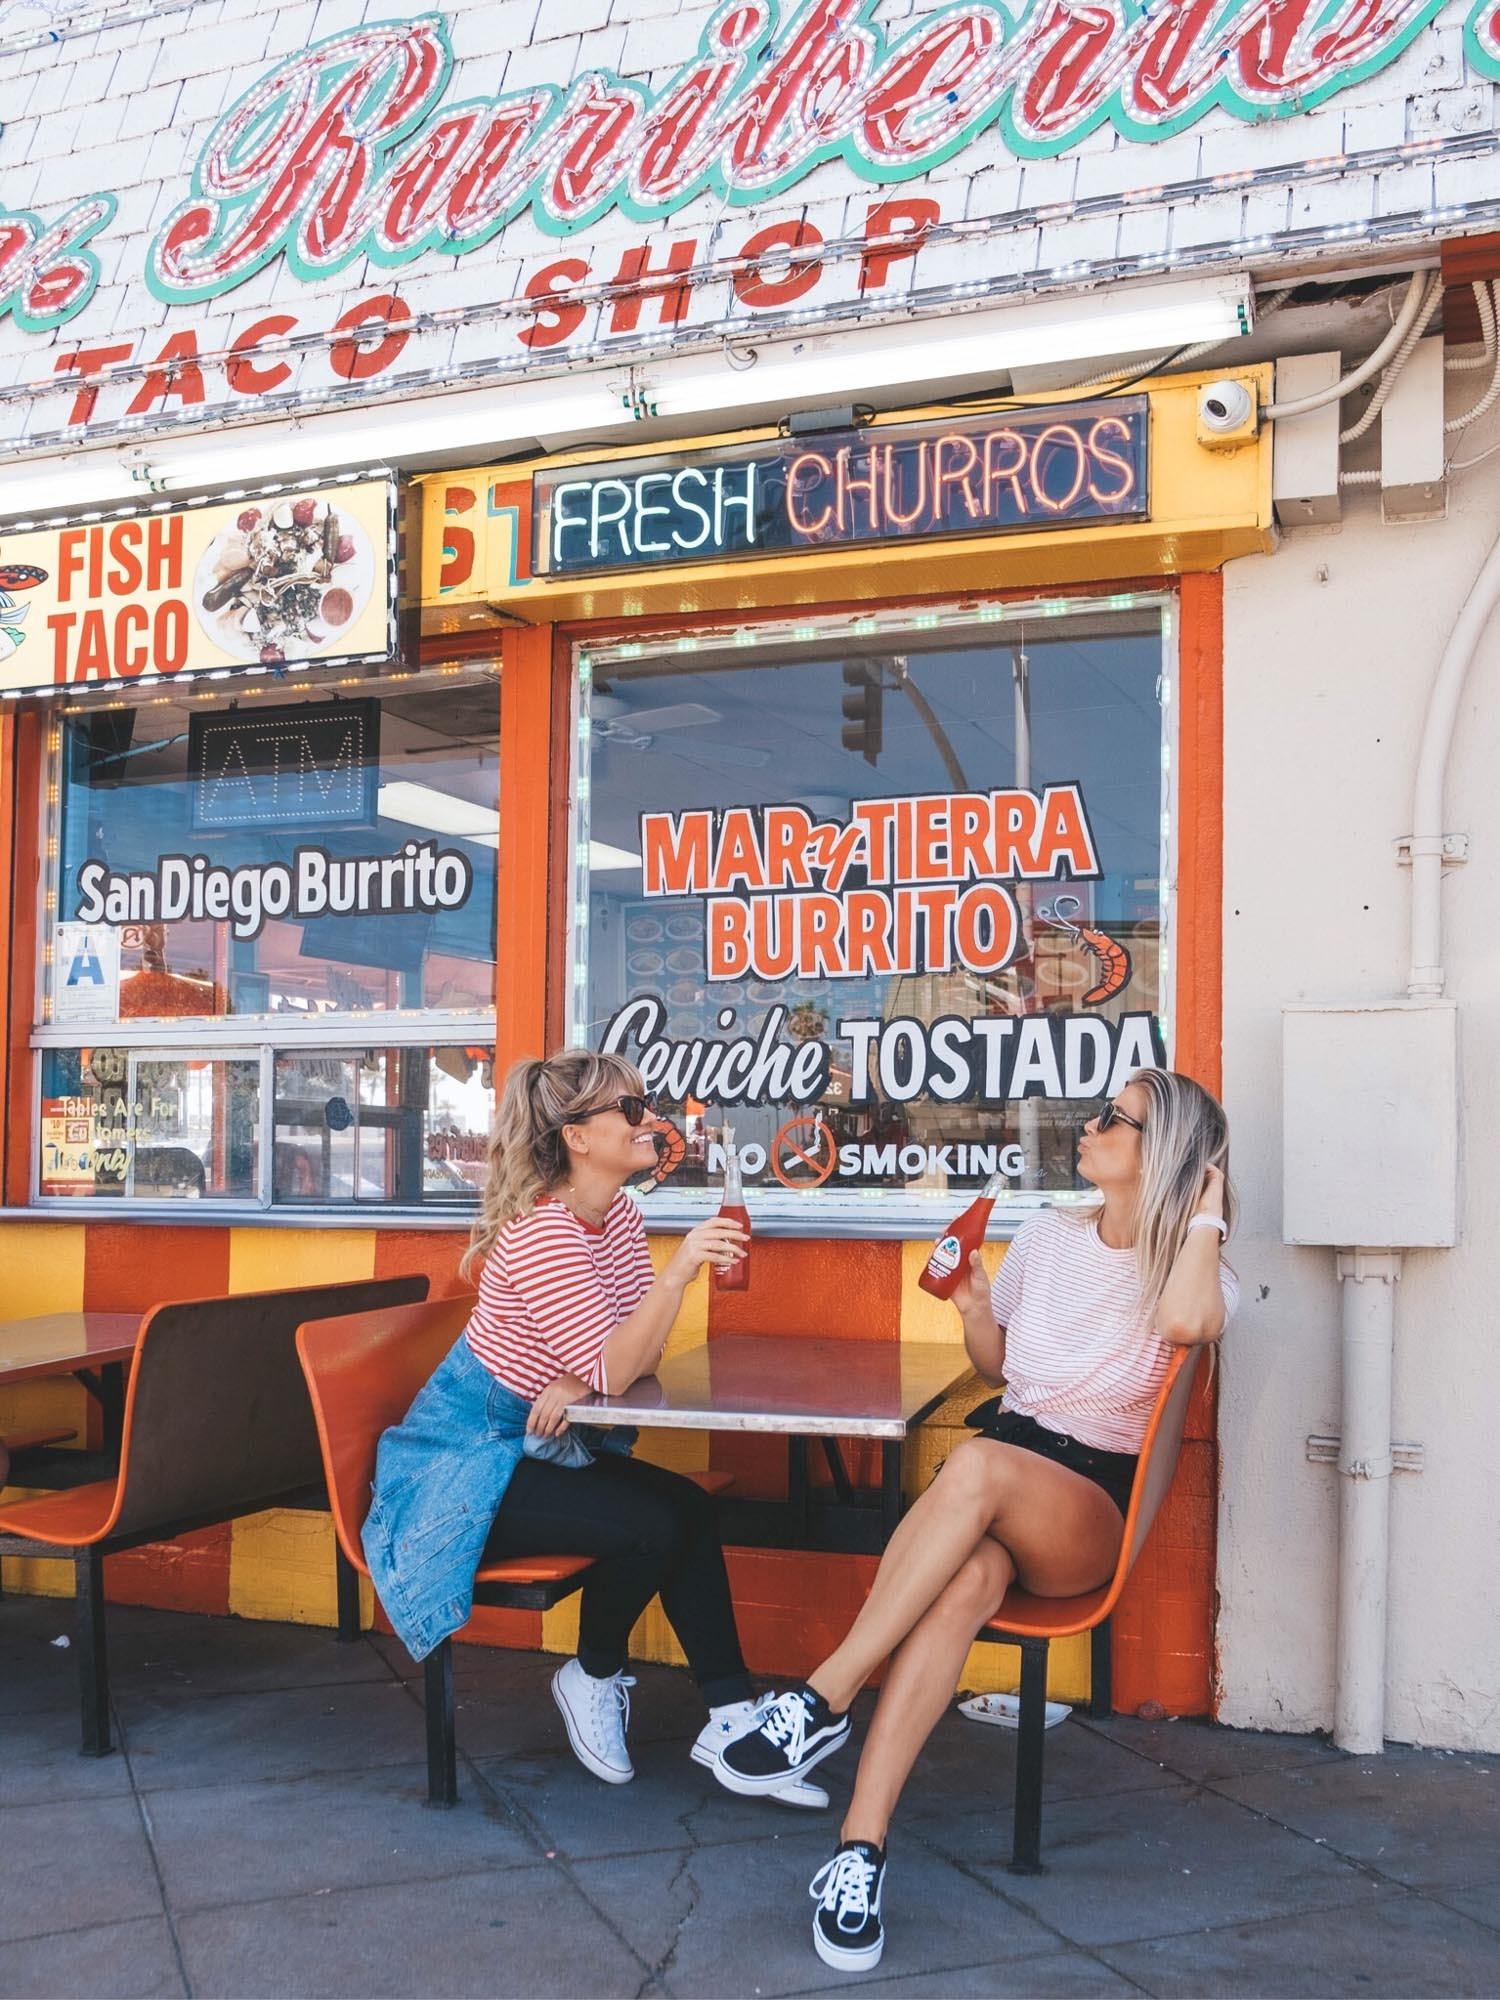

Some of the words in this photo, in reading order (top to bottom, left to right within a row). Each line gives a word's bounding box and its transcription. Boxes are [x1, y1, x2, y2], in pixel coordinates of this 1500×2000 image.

[54, 296, 410, 425] TACO
[516, 197, 940, 348] SHOP
[554, 462, 756, 562] FRESH
[786, 417, 1134, 535] CHURROS
[57, 515, 184, 602] FISH
[47, 599, 189, 685] TACO
[207, 728, 353, 807] ATM
[851, 784, 1101, 888] TIERRA
[77, 862, 155, 924] San
[160, 857, 291, 940] Diego
[297, 842, 467, 914] Burrito
[706, 881, 1019, 982] BURRITO
[66, 934, 105, 986] A
[601, 997, 824, 1102] Ceviche
[839, 1013, 1163, 1101] TOSTADA
[58, 1095, 108, 1117] Tables
[114, 1097, 144, 1118] Are
[151, 1097, 178, 1118] For
[67, 1122, 151, 1143] Cutomers
[707, 1142, 767, 1175] NO
[838, 1143, 1026, 1178] SMOKING
